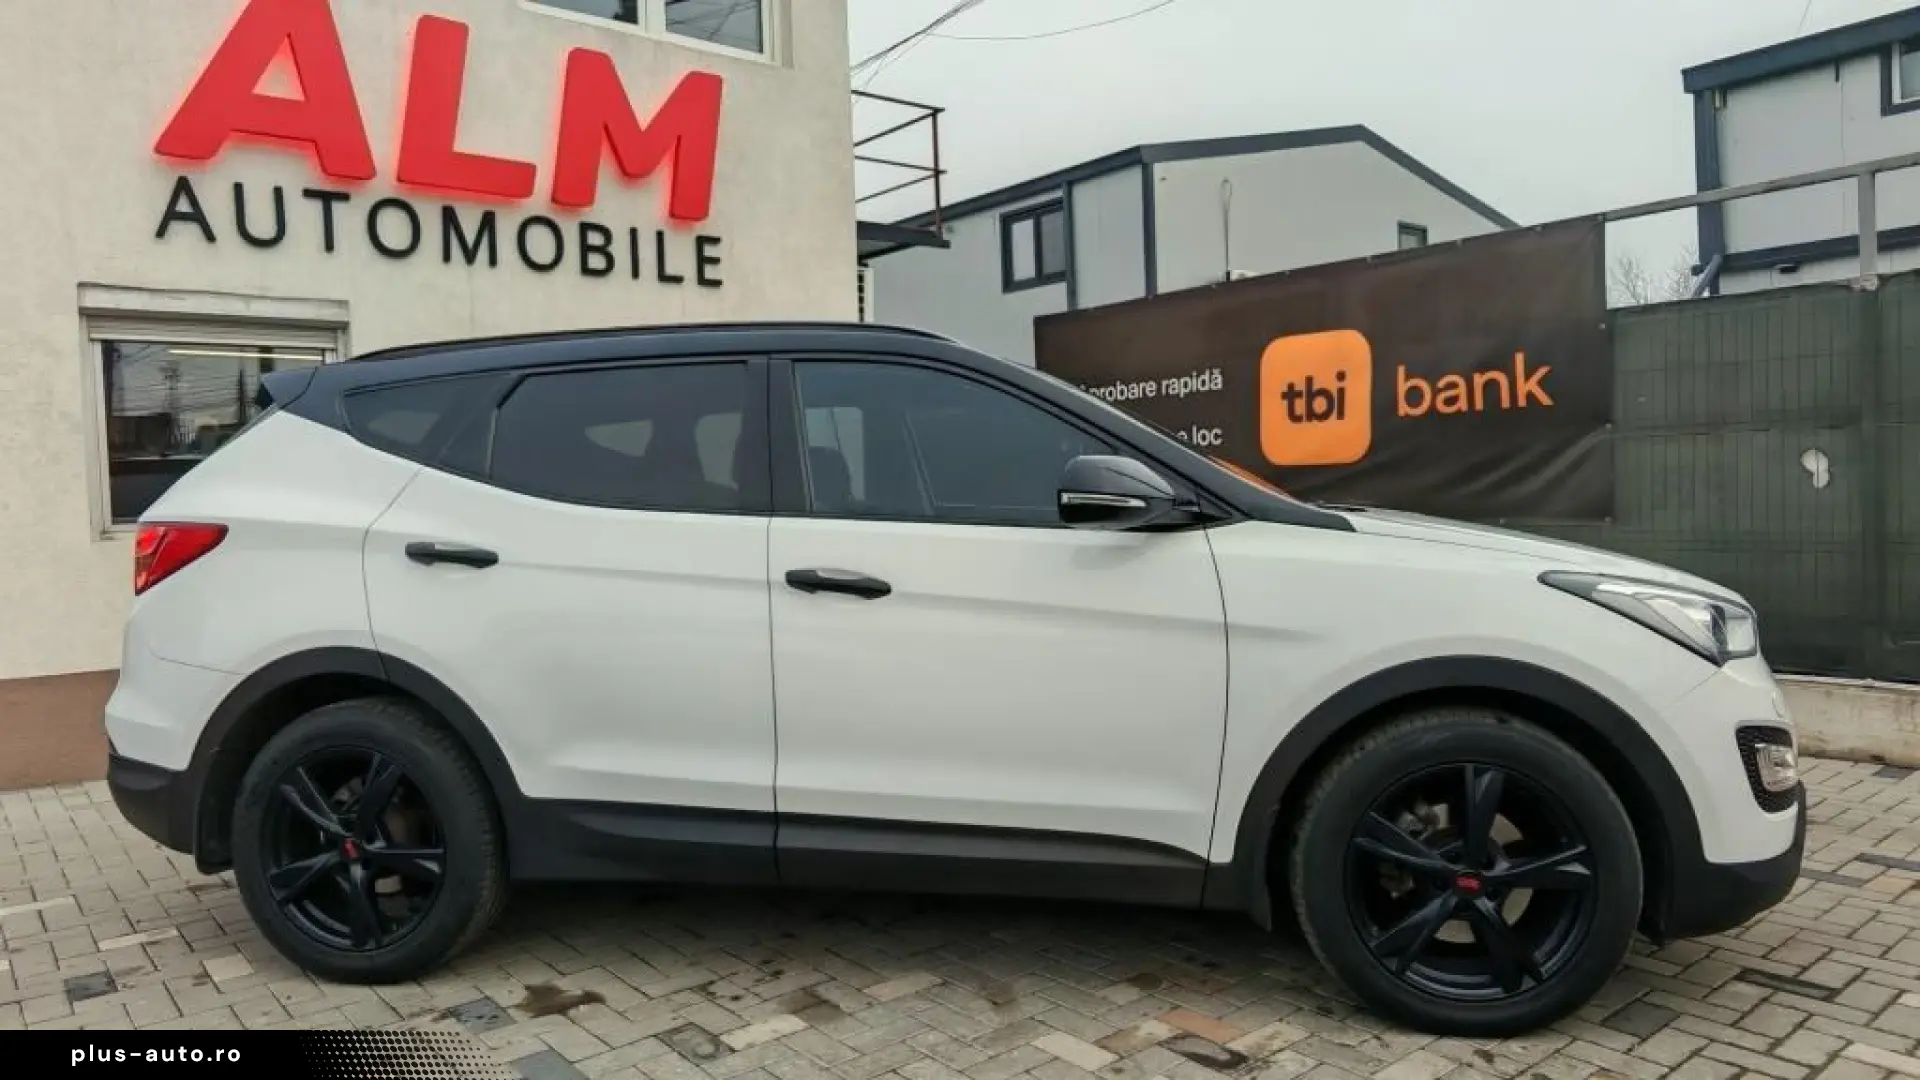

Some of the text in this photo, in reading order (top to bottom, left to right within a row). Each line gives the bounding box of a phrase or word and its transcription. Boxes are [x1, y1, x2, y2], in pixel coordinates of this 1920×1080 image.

[154, 0, 724, 222] ALM
[155, 175, 724, 288] AUTOMOBILE
[1161, 368, 1223, 398] rapidă
[1281, 351, 1554, 424] tbi bank
[1192, 424, 1223, 446] loc
